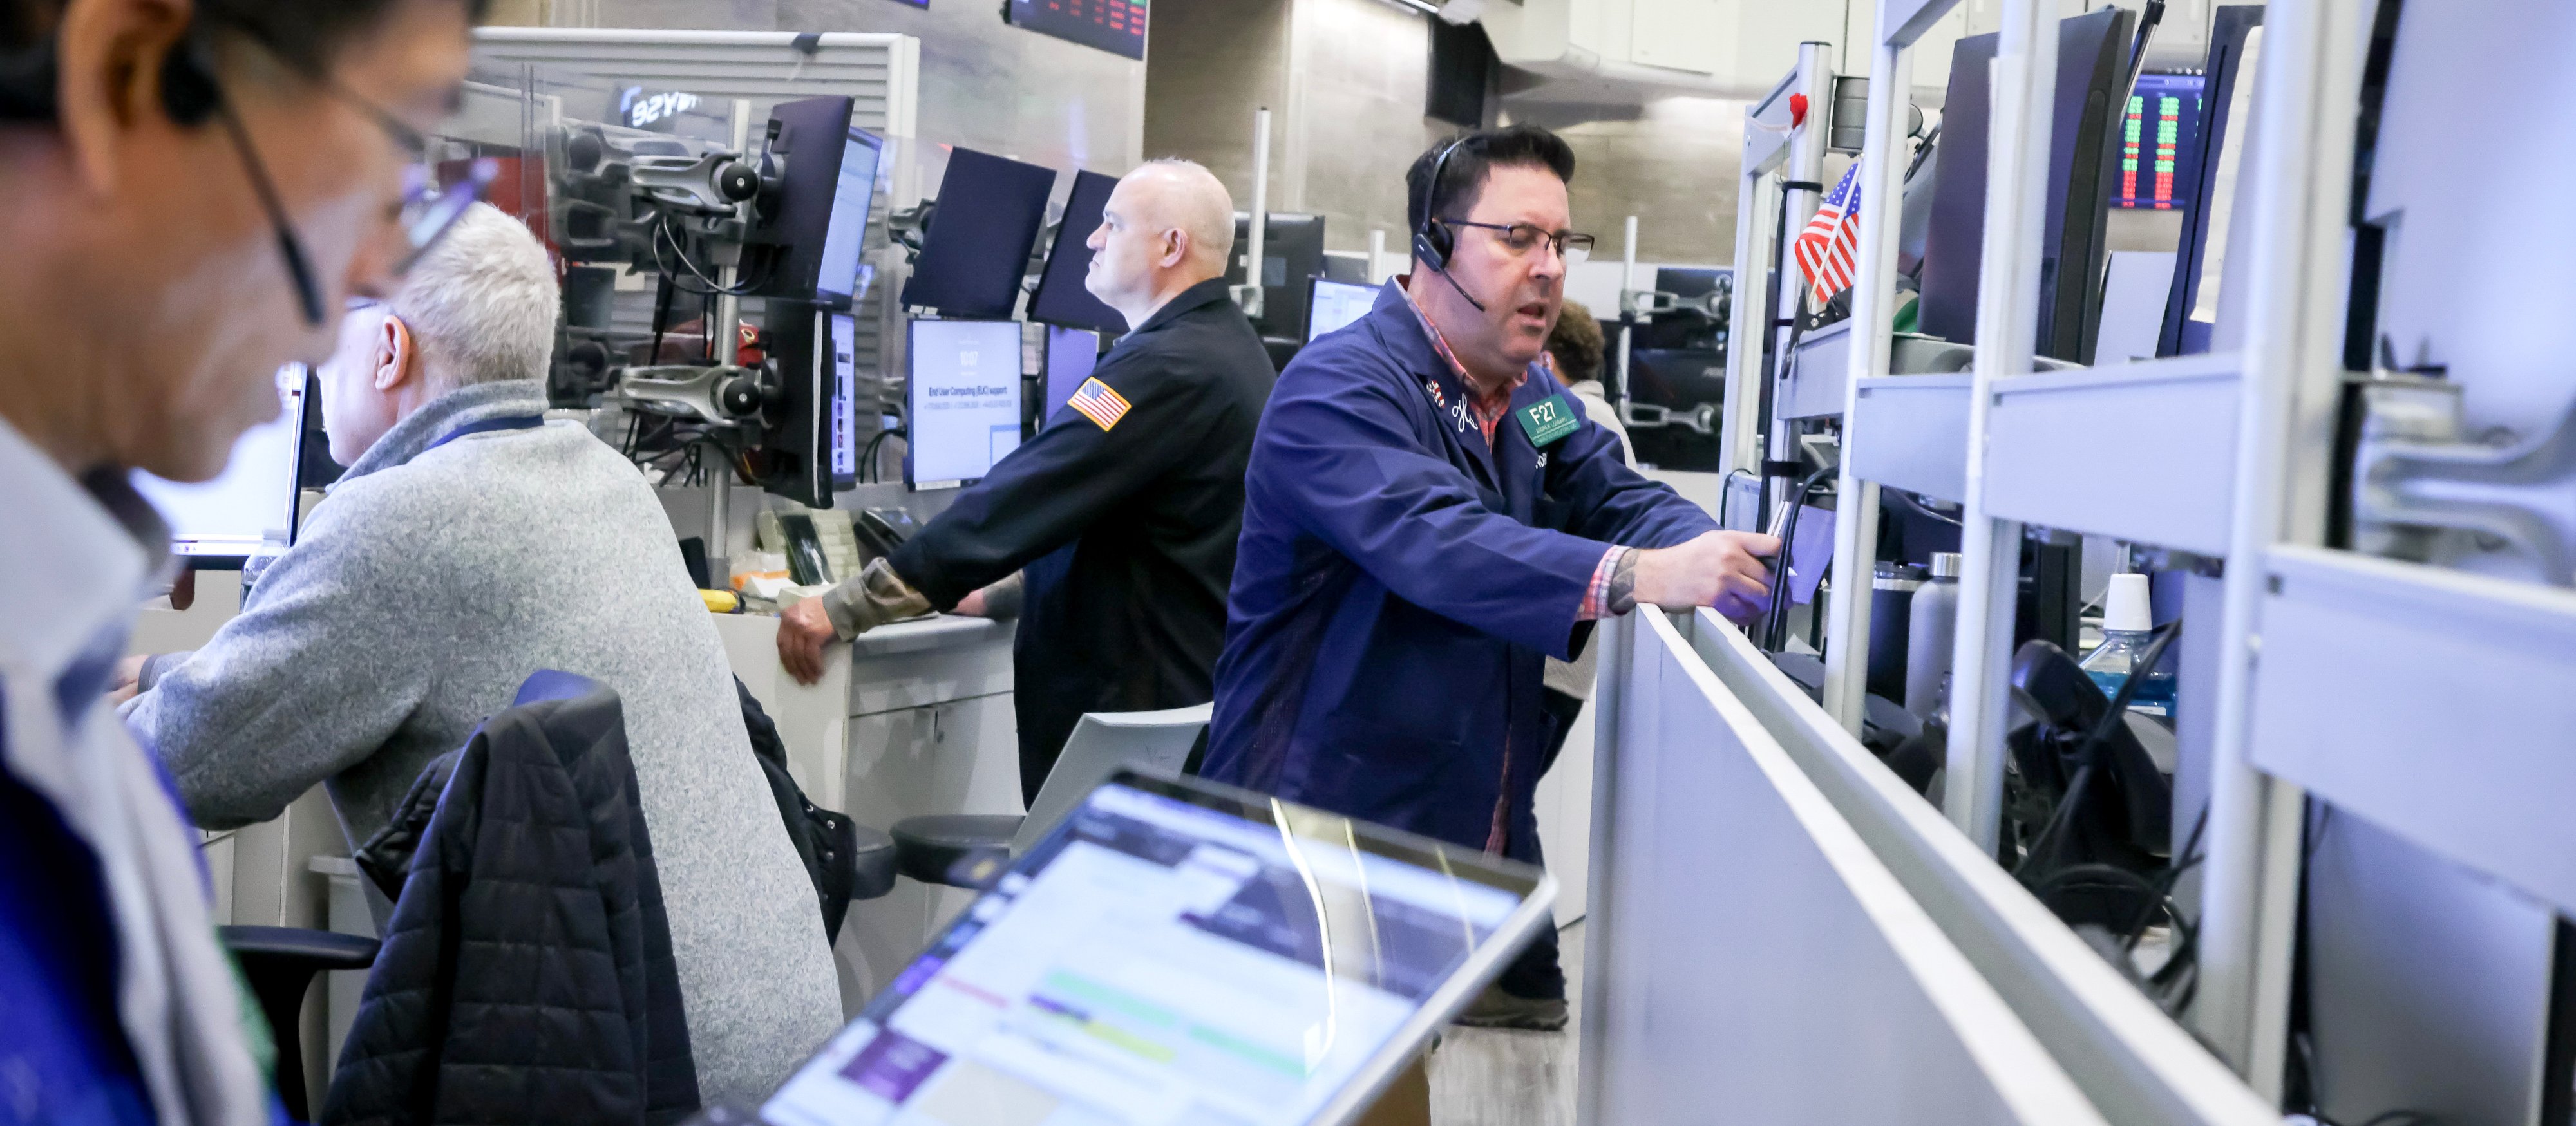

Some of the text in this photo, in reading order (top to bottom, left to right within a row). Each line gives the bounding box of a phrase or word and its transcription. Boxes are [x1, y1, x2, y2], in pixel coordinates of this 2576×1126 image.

[929, 387, 938, 396] End
[950, 386, 975, 397] Computing
[1529, 401, 1557, 426] F27
